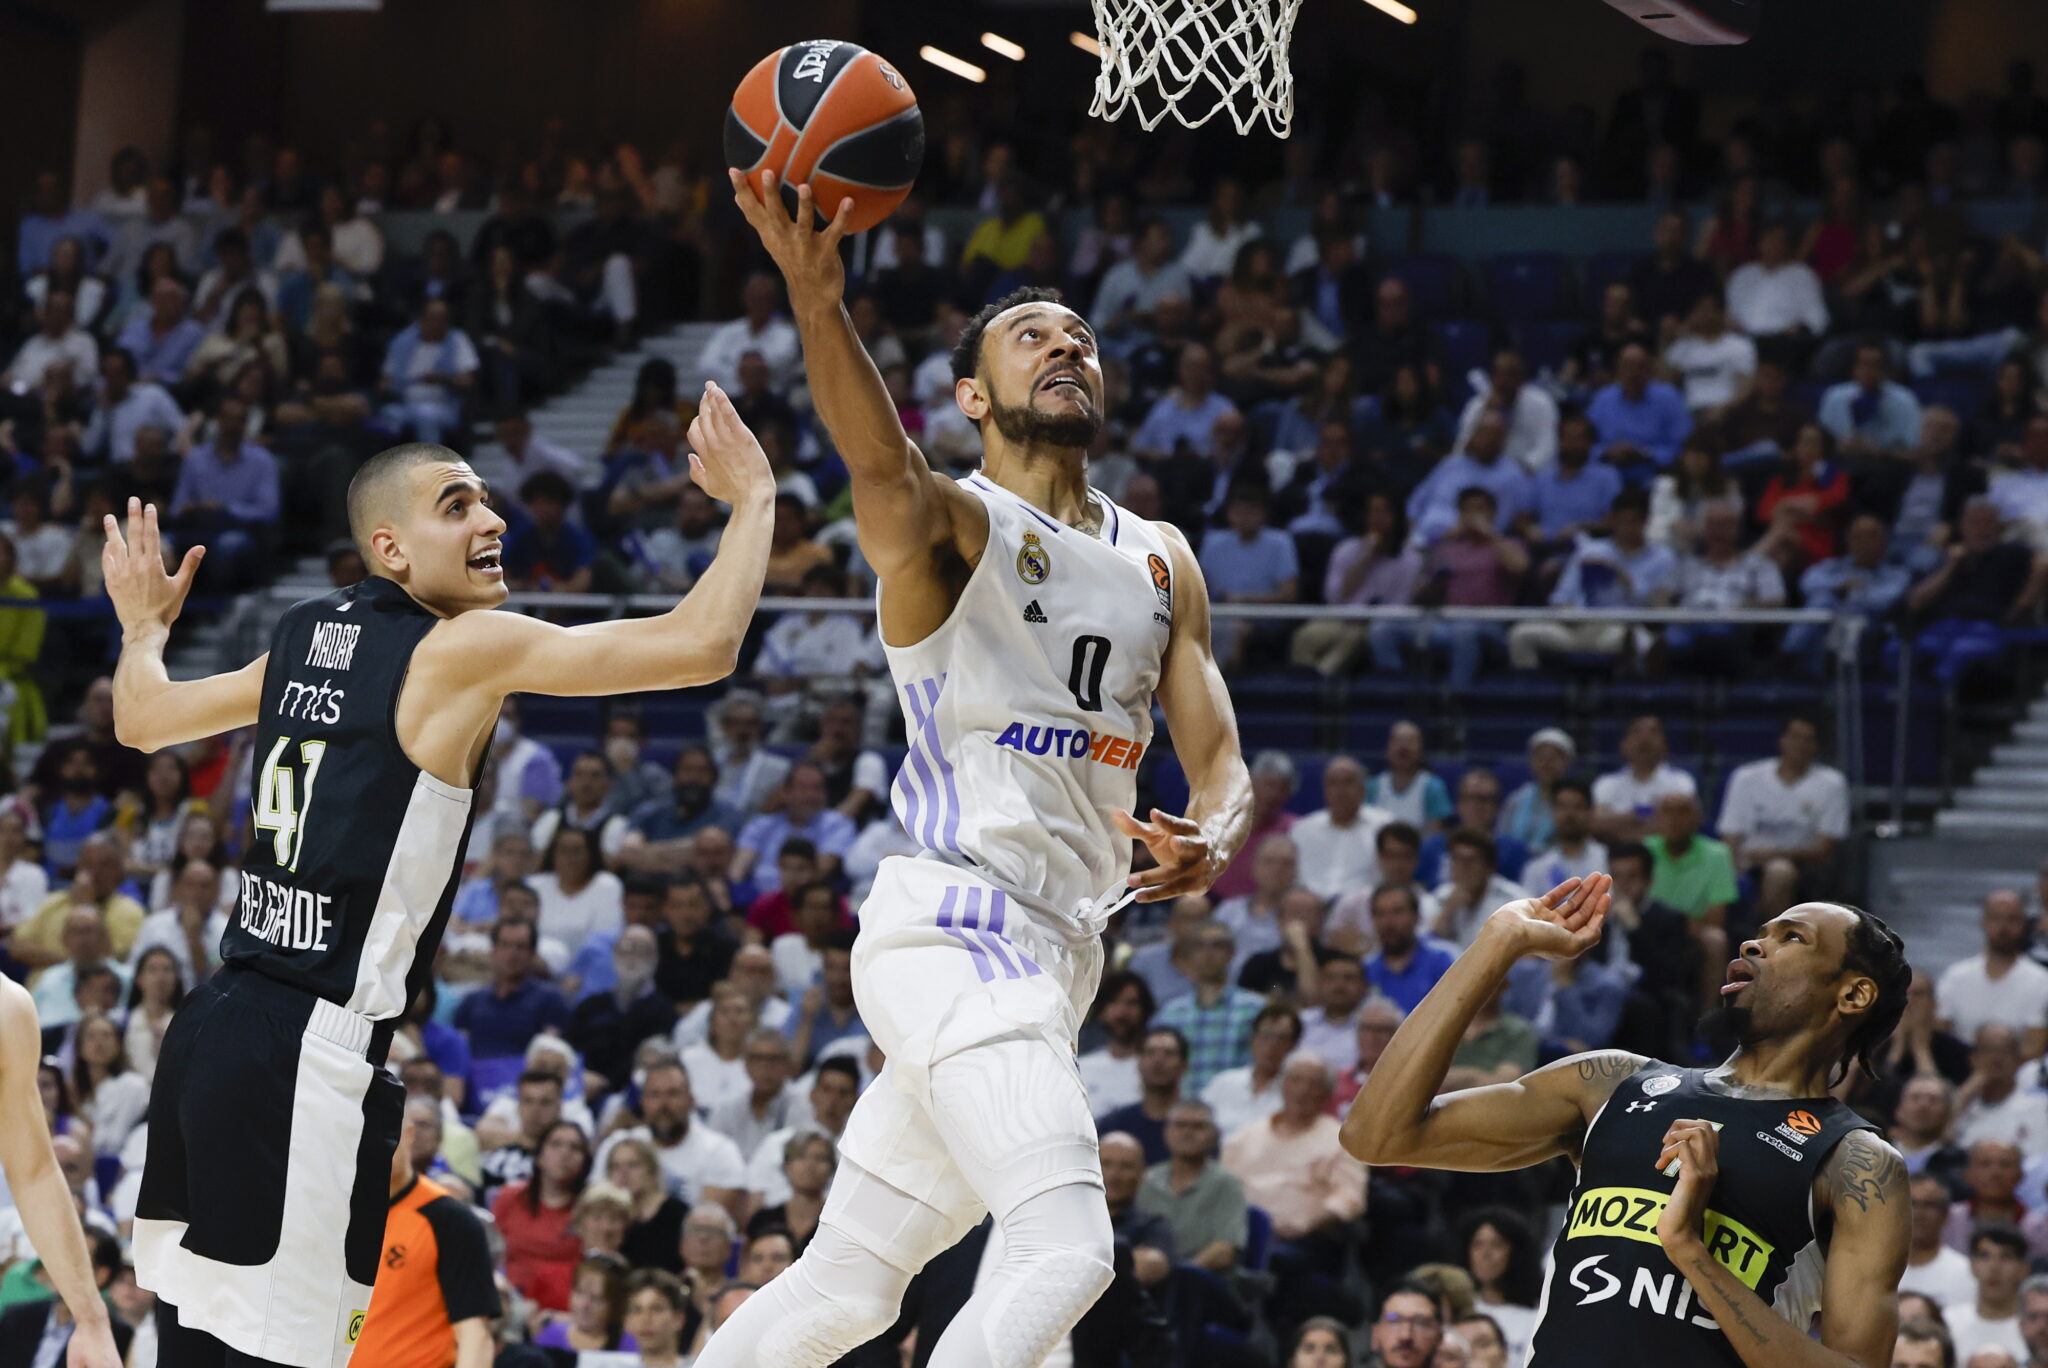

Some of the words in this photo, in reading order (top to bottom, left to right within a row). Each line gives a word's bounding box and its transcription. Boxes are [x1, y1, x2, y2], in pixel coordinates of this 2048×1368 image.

[304, 621, 361, 671] MADAR
[1068, 634, 1111, 711] 0
[279, 679, 345, 724] mts
[256, 735, 327, 874] 41
[240, 870, 333, 951] BELGRADE
[1757, 1131, 1804, 1161] oneteam
[1573, 1195, 1764, 1273] MOZRT
